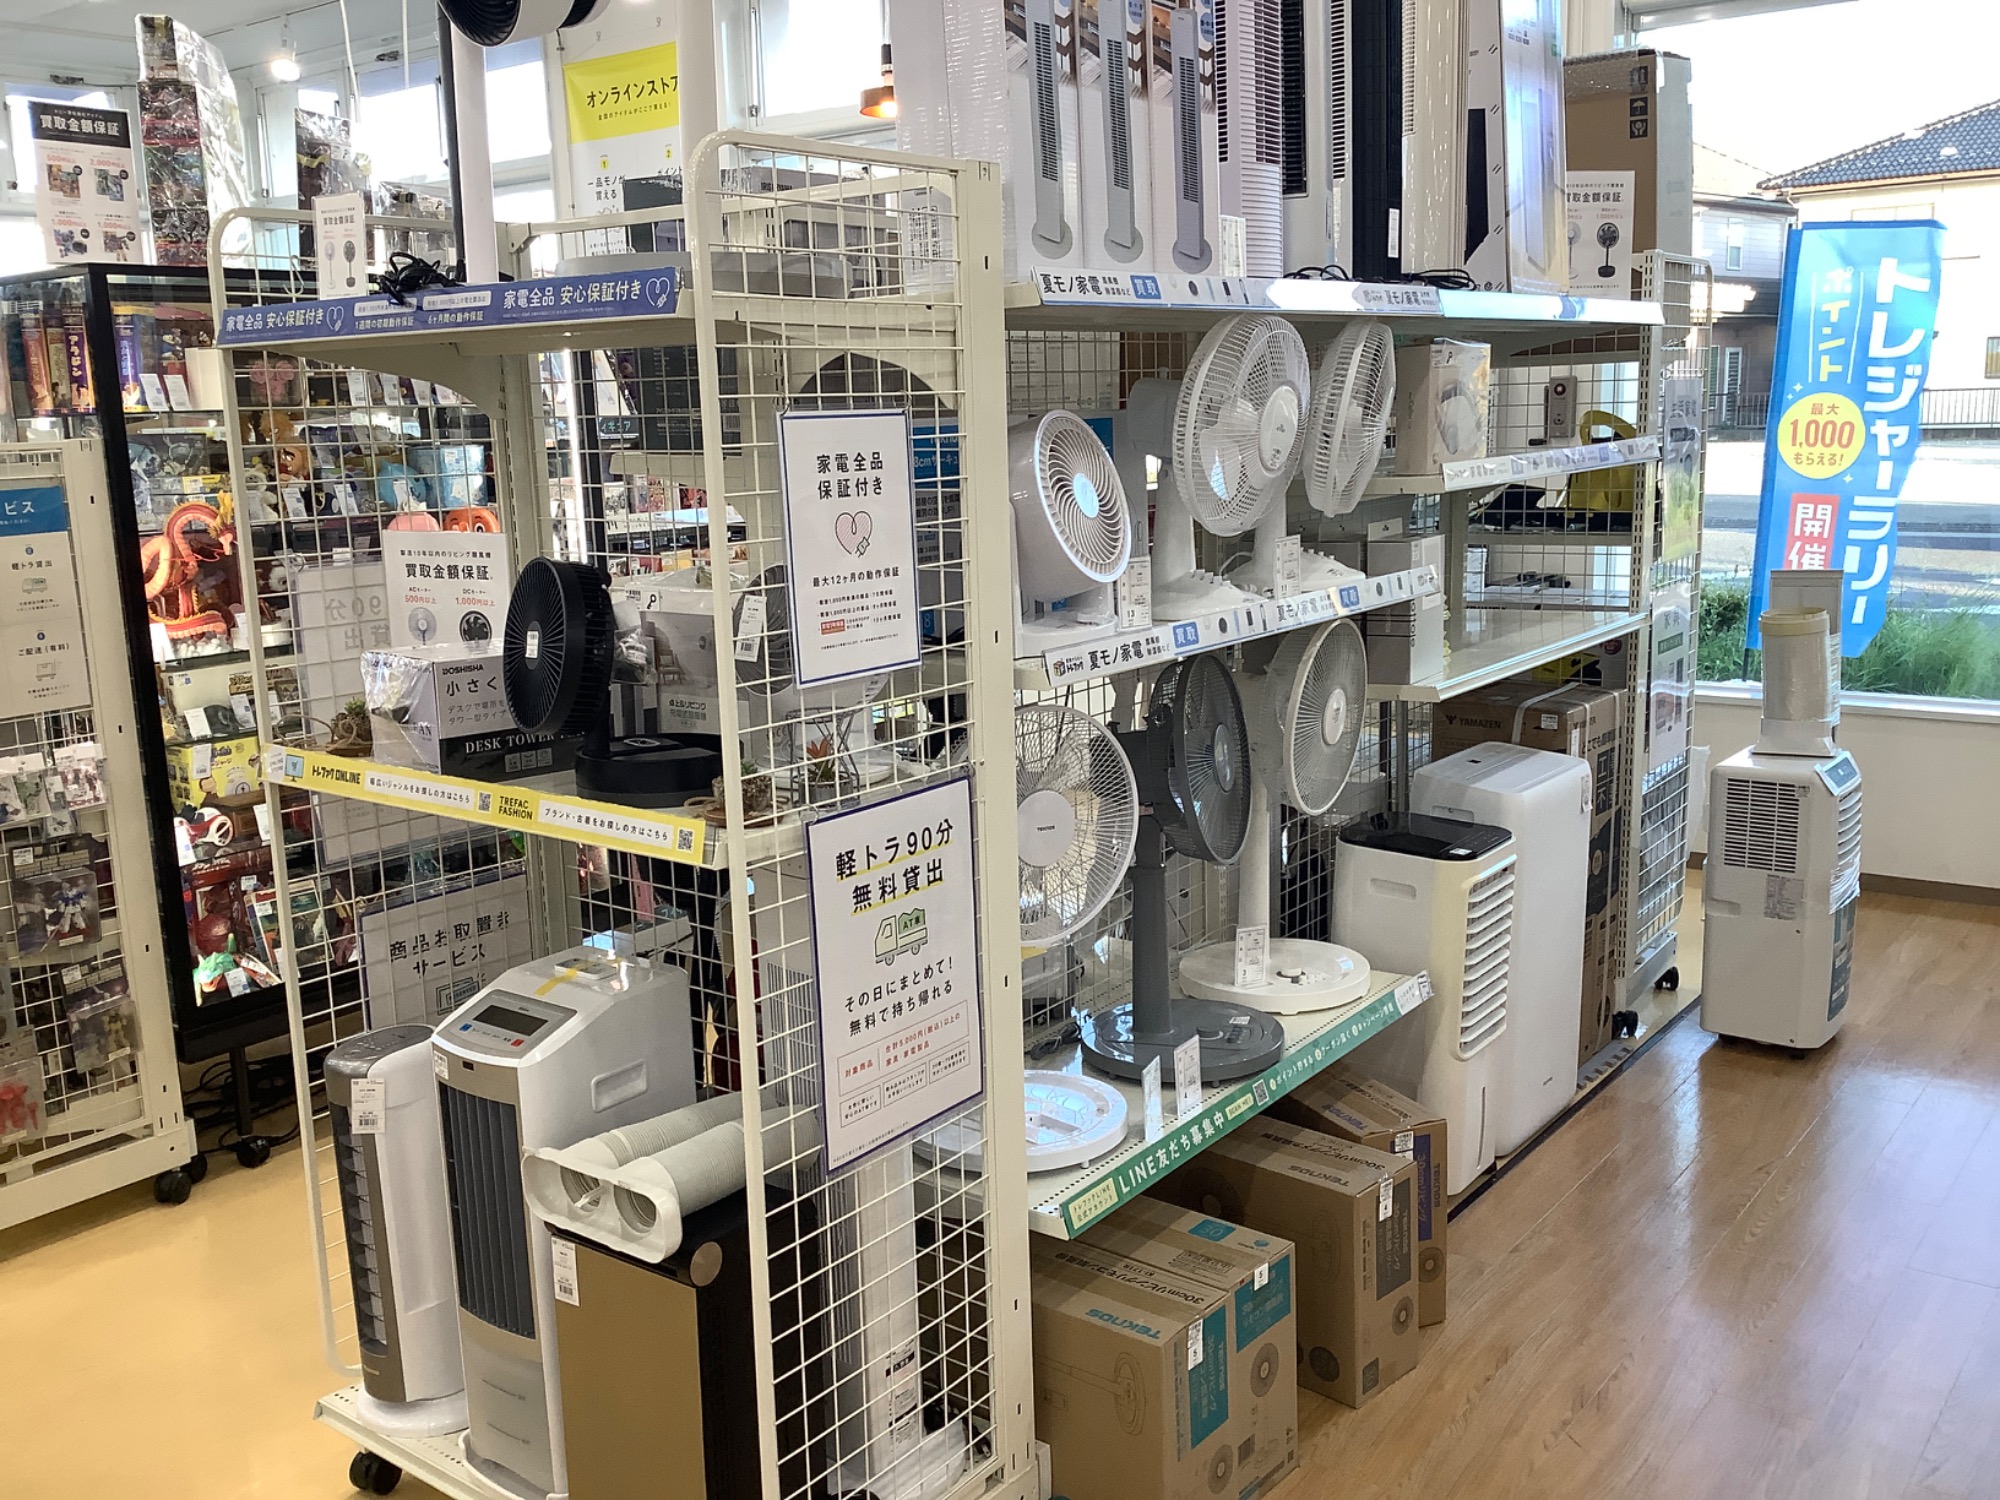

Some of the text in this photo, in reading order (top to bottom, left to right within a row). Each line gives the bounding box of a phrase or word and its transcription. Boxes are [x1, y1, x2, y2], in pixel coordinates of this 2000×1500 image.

[586, 75, 679, 109] オンラインストア
[39, 114, 120, 136] 買取金額保証
[596, 188, 618, 202] 買える
[560, 279, 642, 306] 安心保証付き
[1039, 273, 1102, 295] 夏モノ家電
[1134, 278, 1159, 296] 買取
[503, 287, 555, 310] 家電全品
[226, 313, 263, 332] 家電全品
[266, 308, 324, 329] 安心保証付き
[1818, 265, 1855, 383] ポイント
[68, 335, 83, 377] アラジン
[1810, 403, 1840, 416] 最大
[1789, 418, 1855, 450] 1,000
[1841, 257, 1931, 625] トレジャーラリー
[816, 451, 884, 475] 家電全品
[1792, 452, 1844, 467] もらえる!
[817, 476, 884, 500] 保証付き
[5, 501, 35, 515] ビス
[1788, 503, 1834, 569] 開催
[11, 560, 53, 571] 軽トラ貸出
[1175, 627, 1198, 645] 買取
[1088, 640, 1145, 671] 夏モノ家電
[442, 664, 484, 676] DOSHISHA
[446, 676, 498, 697] 小さく
[1459, 716, 1501, 729] YAMAZEN
[465, 737, 501, 755] DESK
[499, 795, 529, 809] TREFAC
[498, 806, 533, 821] FASHION
[835, 818, 954, 881] 軽トラ90分
[851, 857, 944, 914] 無料貸出
[902, 916, 921, 931] AT車
[413, 943, 487, 979] サービス
[845, 956, 952, 1013] その日にまとめて!
[849, 980, 952, 1037] 無料で持ち帰れる
[845, 1059, 874, 1078] 対象商品
[1118, 1111, 1226, 1195] LINE友だち募集中
